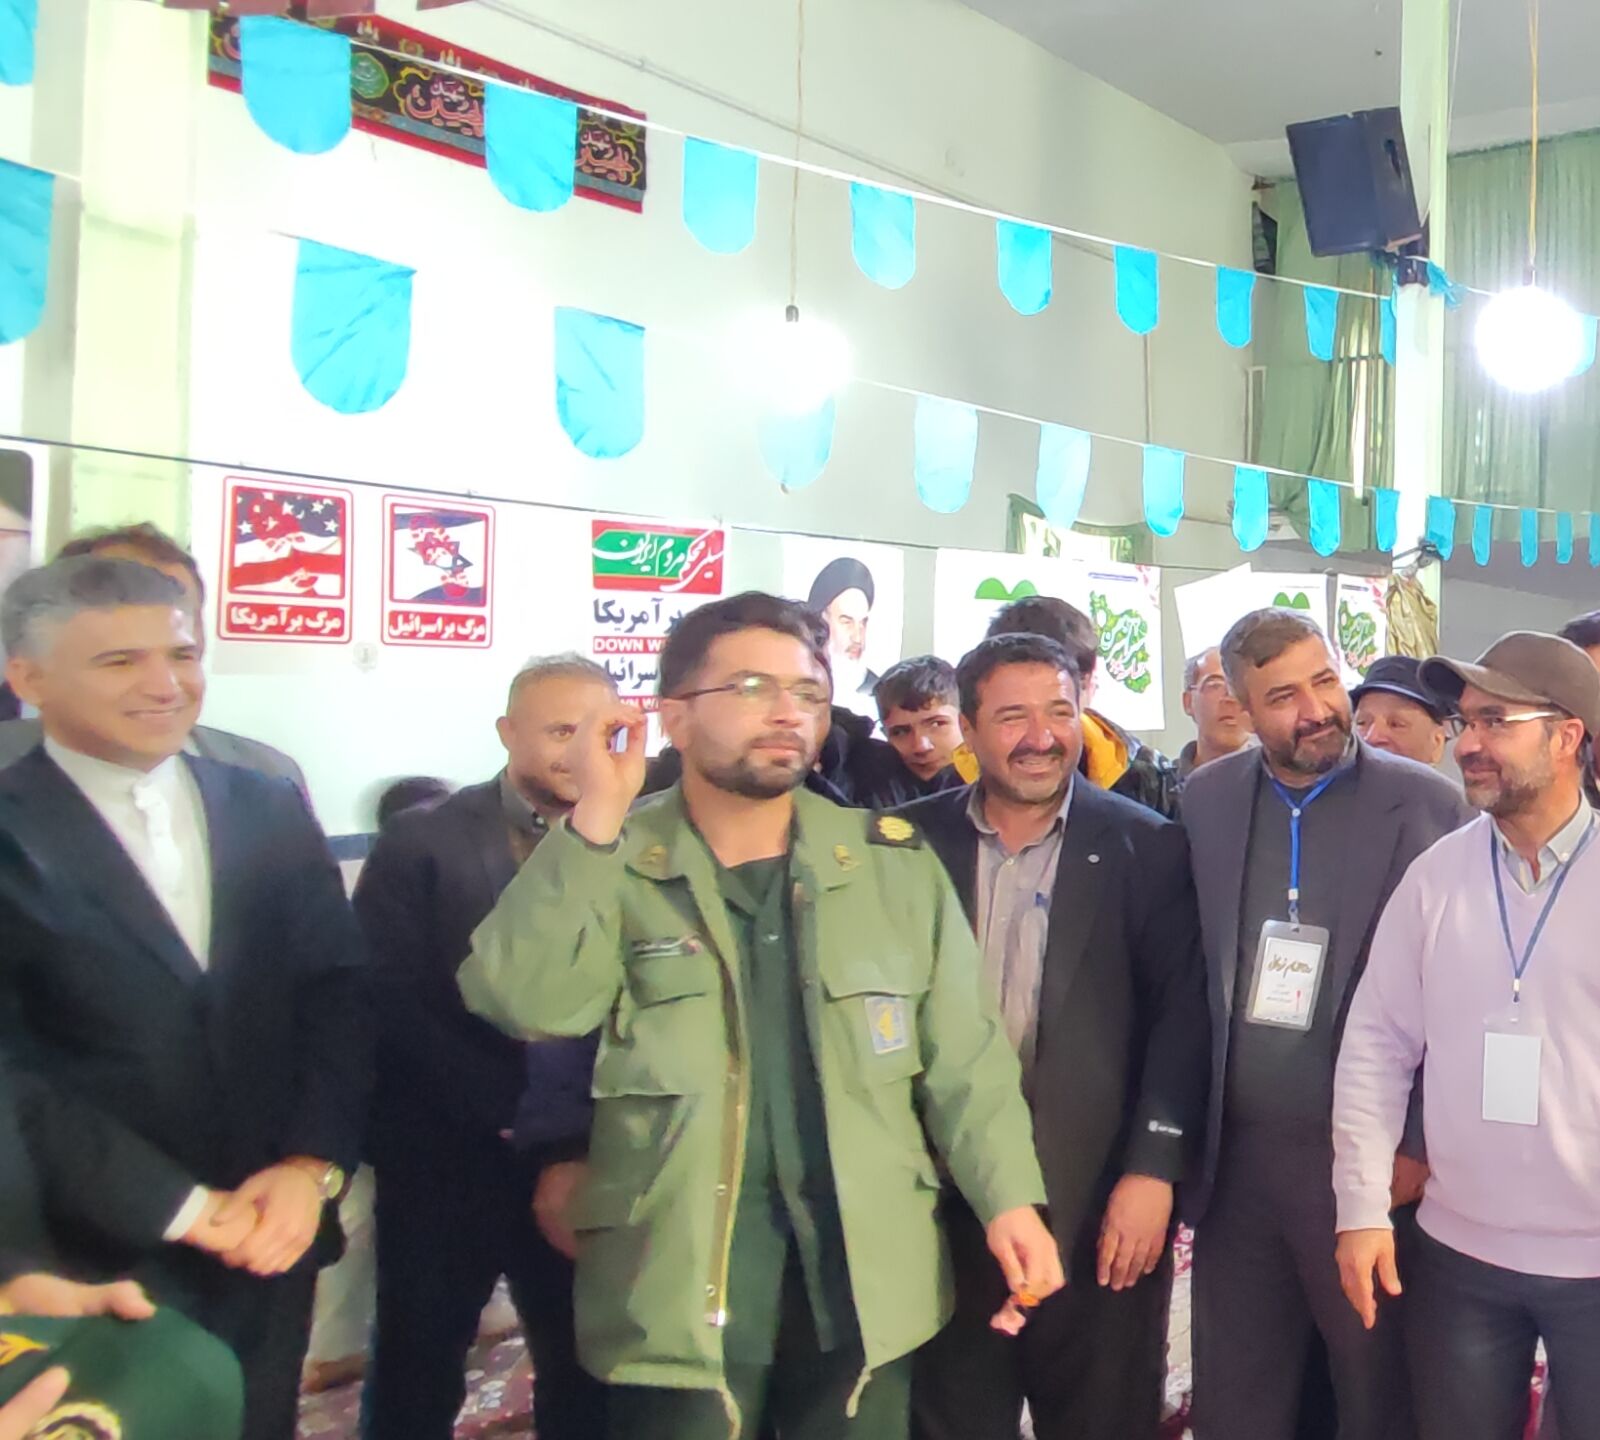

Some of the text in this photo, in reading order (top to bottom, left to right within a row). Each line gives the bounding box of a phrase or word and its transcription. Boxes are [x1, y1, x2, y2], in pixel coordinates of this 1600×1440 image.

[229, 605, 342, 635] مرگ بر آمریکا
[388, 613, 486, 641] مرگ بر اسرائیل
[593, 597, 664, 634] آمریکا
[593, 638, 644, 653] DOWN
